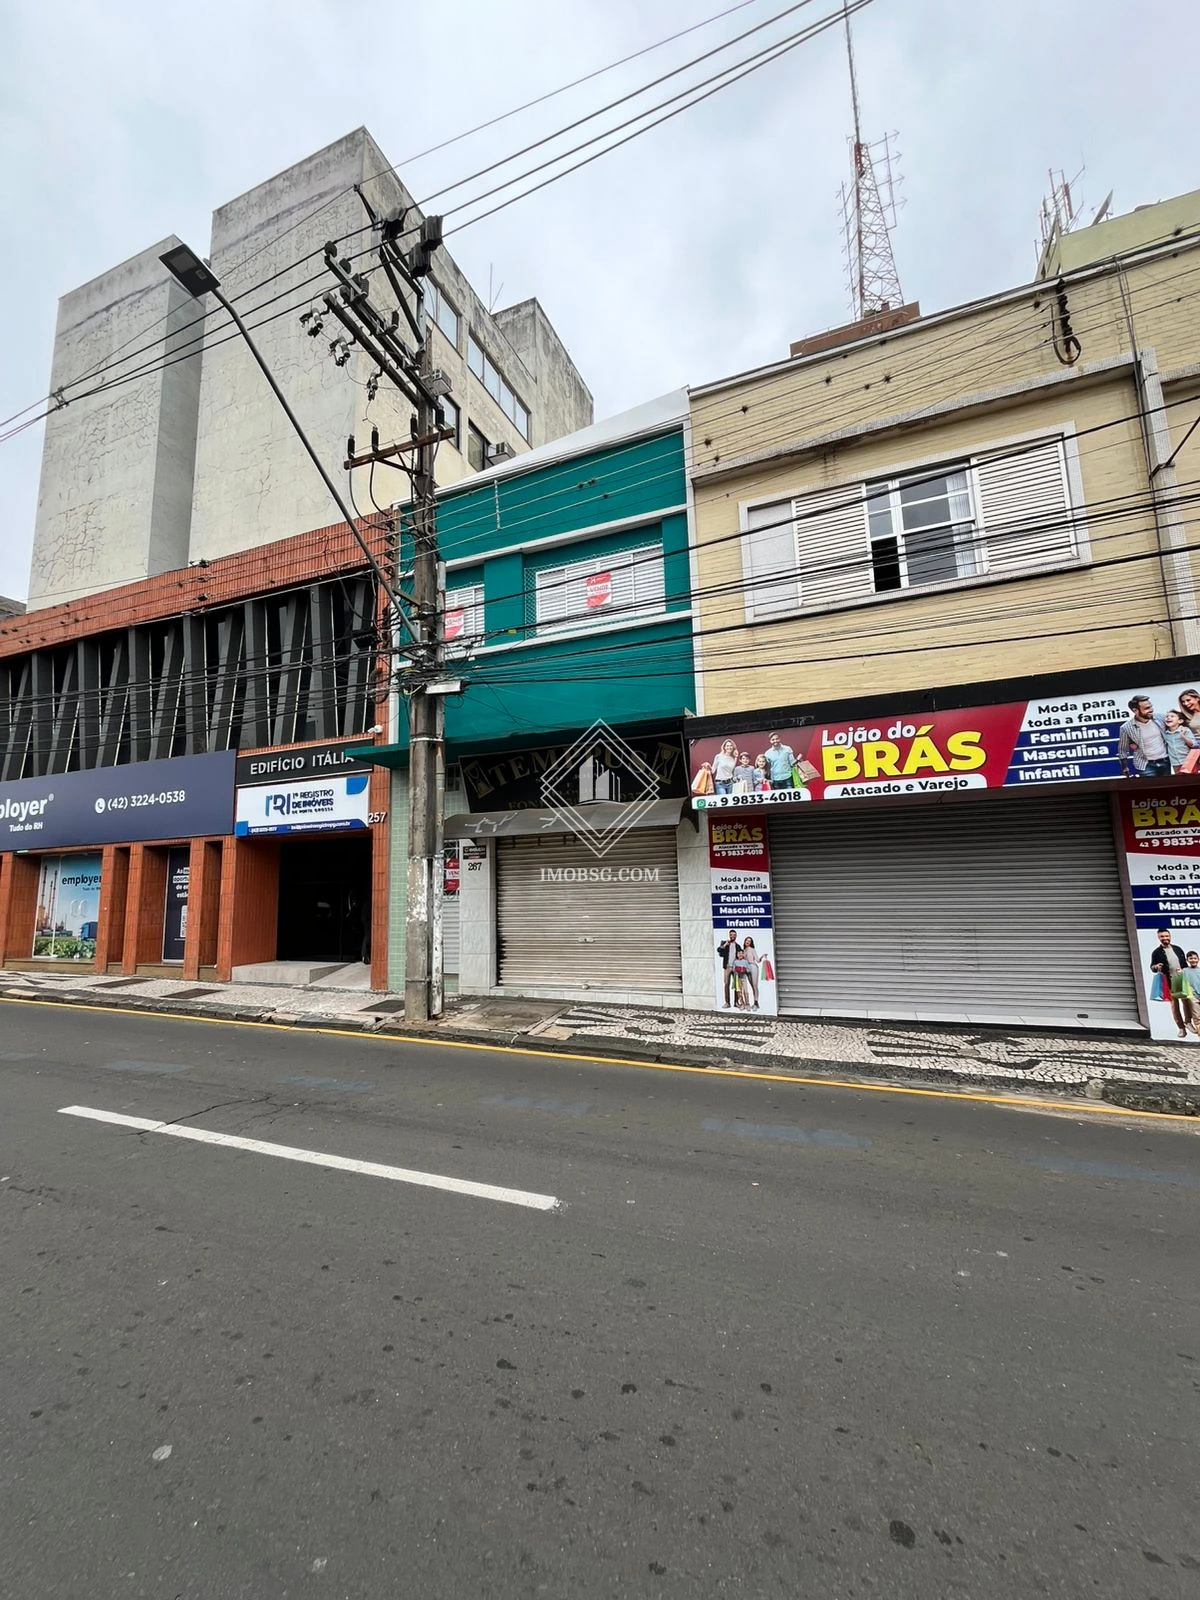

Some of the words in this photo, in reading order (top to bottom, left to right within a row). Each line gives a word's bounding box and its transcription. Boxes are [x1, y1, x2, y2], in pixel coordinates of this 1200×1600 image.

[1038, 702, 1078, 715] Moda
[1083, 698, 1116, 712] para
[1028, 715, 1061, 728] toda
[1065, 715, 1073, 725] a
[1077, 709, 1130, 724] família
[822, 727, 882, 750] Lojão
[887, 721, 916, 740] do
[1030, 727, 1110, 744] Feminina
[821, 724, 988, 782] BRÁS
[1022, 745, 1110, 762] Masculina
[250, 756, 304, 775] EDIFÍCIO
[1019, 764, 1081, 781] Infantil
[300, 789, 334, 799] REGISTRO
[840, 783, 901, 797] Atacado
[905, 783, 914, 792] e
[918, 777, 969, 791] Varejo
[107, 797, 128, 811] (42)
[130, 790, 186, 807] 3224-0538
[720, 797, 729, 807] 9
[732, 790, 802, 806] 9833-4018
[1131, 798, 1168, 810] Lojão
[1170, 796, 1188, 807] do
[368, 811, 387, 823] 257
[9, 824, 24, 832] Tudo
[25, 823, 33, 831] do
[33, 822, 44, 830] RH
[712, 824, 764, 844] BRÁS
[1145, 827, 1181, 837] Atacado
[1152, 838, 1160, 848] 9
[1162, 837, 1200, 847] 9833-
[727, 848, 764, 857] 9833-4018
[467, 862, 482, 871] 267
[1149, 872, 1176, 882] toda
[740, 882, 768, 890] família
[720, 893, 763, 902] Feminina
[719, 905, 766, 914] Masculina
[726, 918, 760, 927] Infantil
